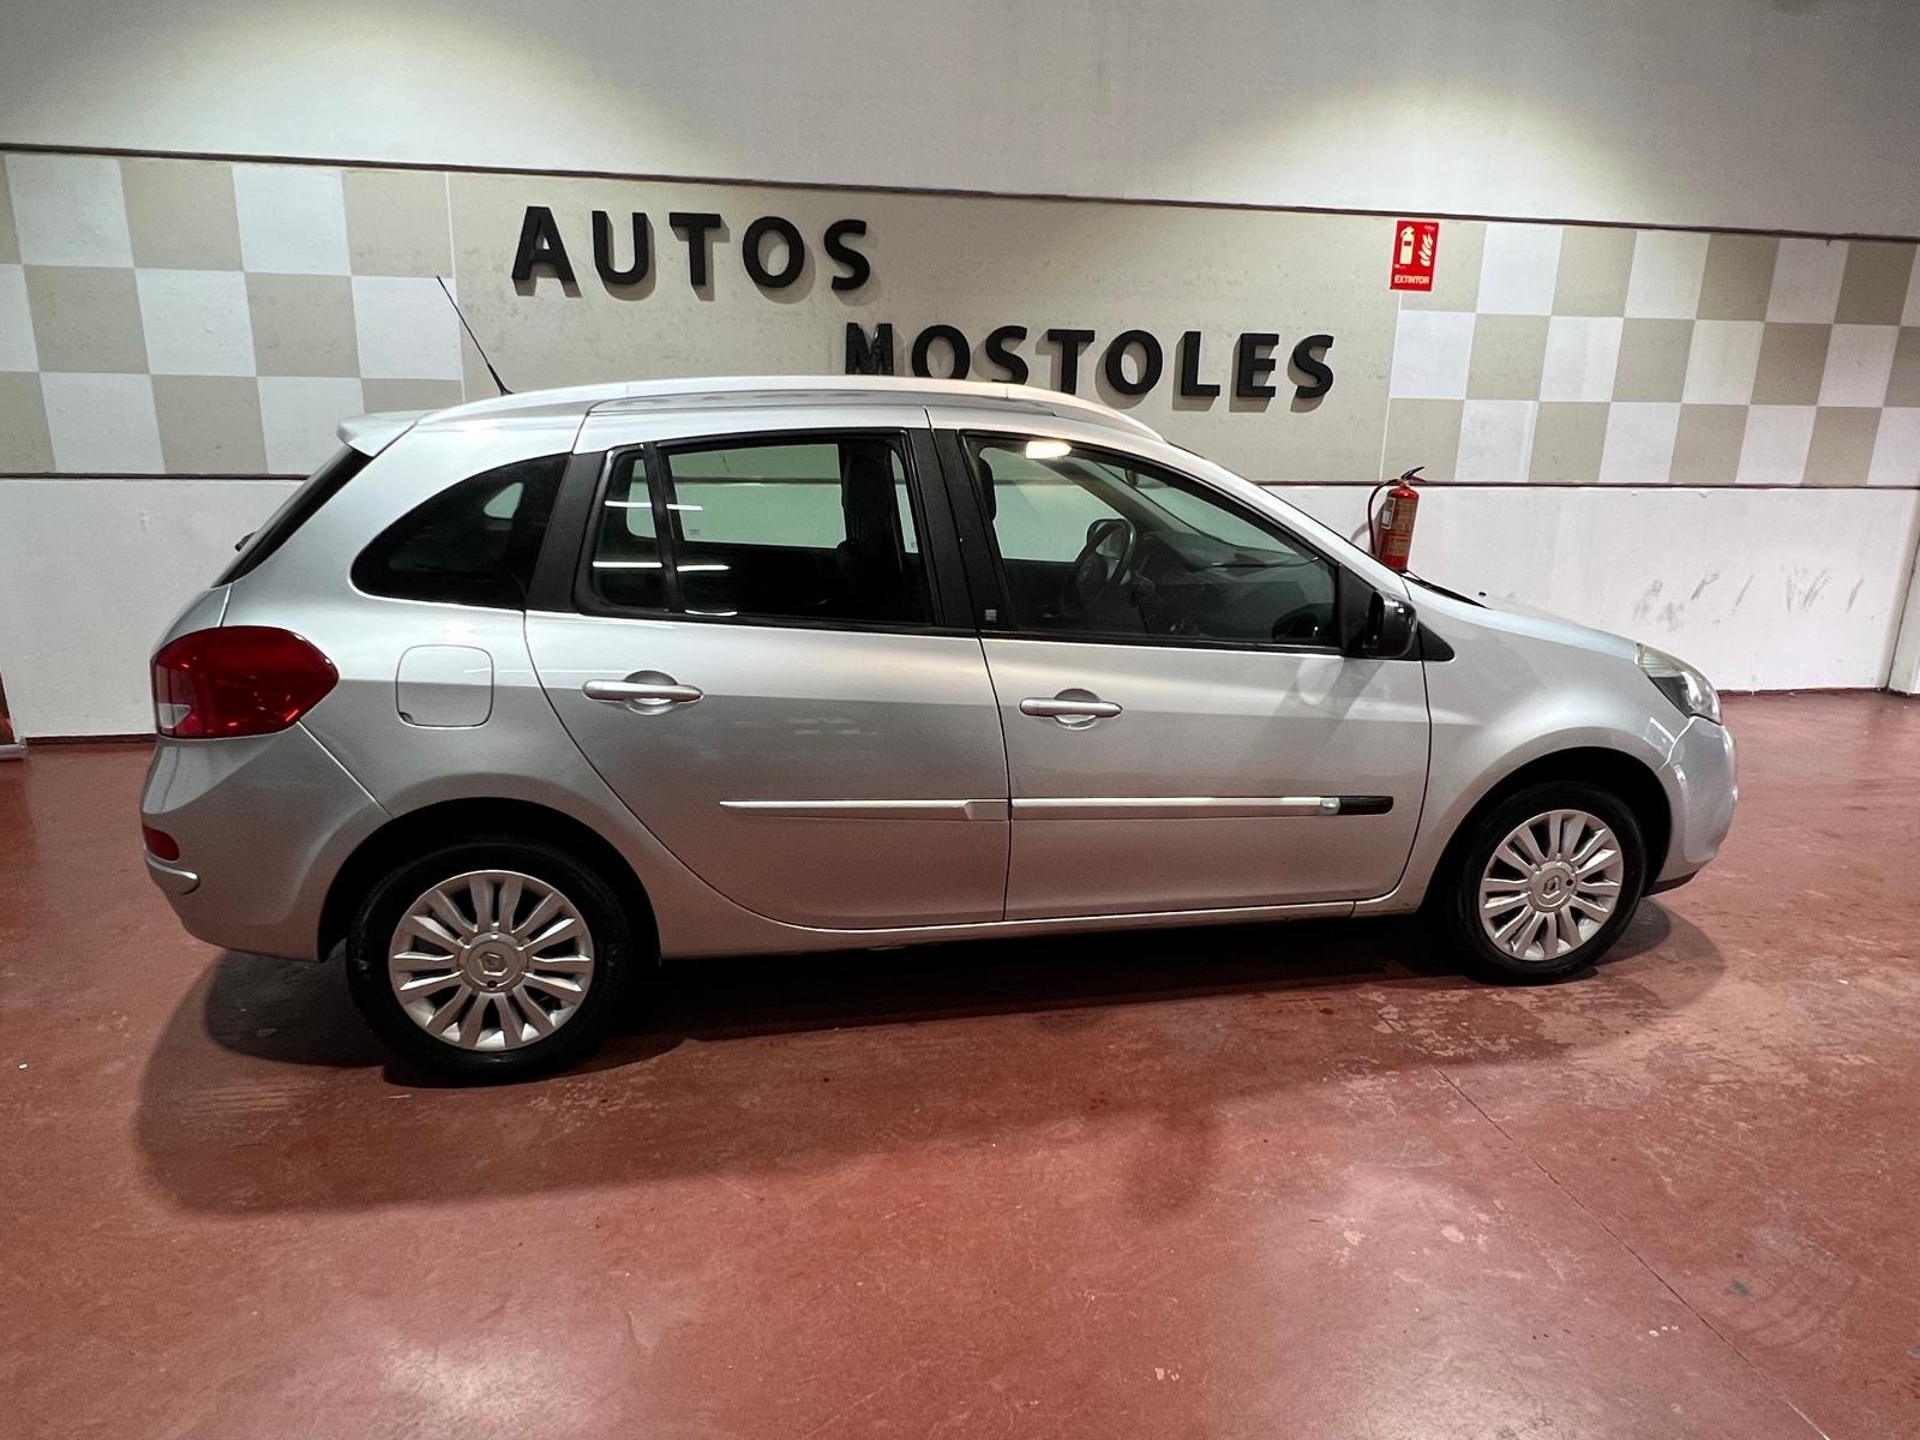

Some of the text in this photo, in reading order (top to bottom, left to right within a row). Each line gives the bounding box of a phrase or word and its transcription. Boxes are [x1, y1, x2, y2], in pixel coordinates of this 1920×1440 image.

[512, 206, 871, 290] AUTOS
[1394, 274, 1430, 285] EXTINTOR
[846, 322, 1334, 399] MOSTOLES
